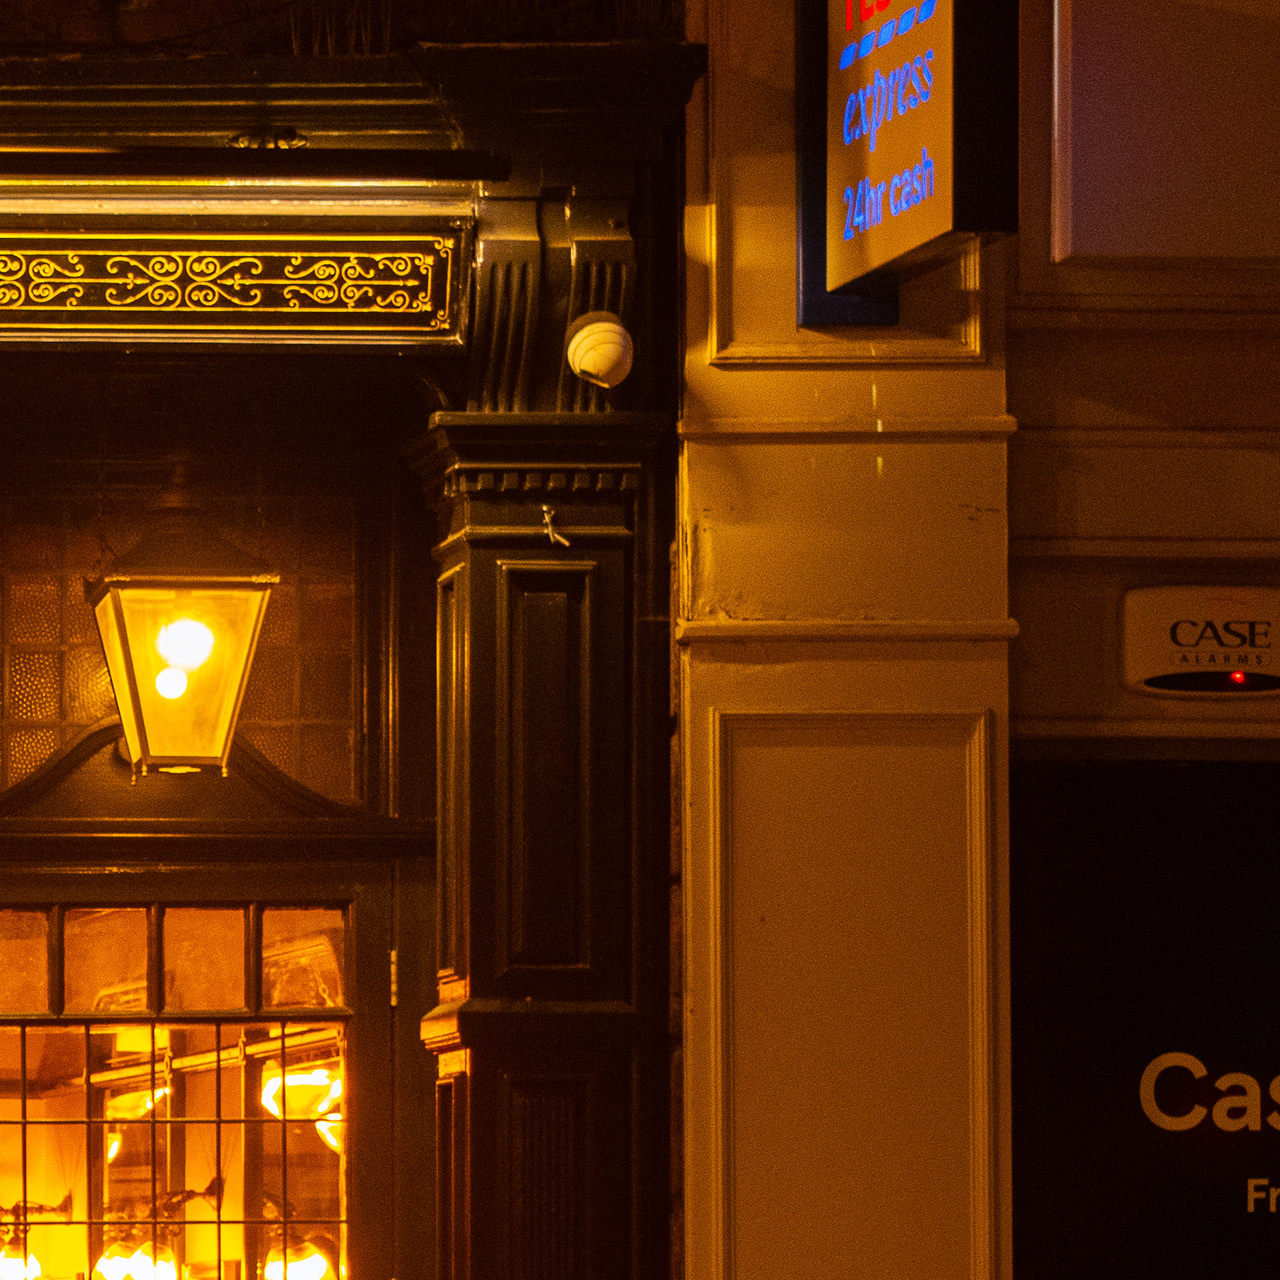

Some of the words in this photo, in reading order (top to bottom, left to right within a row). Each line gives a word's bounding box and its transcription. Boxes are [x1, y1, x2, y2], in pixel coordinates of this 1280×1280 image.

[842, 49, 934, 152] express
[842, 177, 887, 241] 24hr
[889, 147, 935, 216] cash
[1170, 620, 1272, 648] CASE
[1140, 1052, 1280, 1131] Ca
